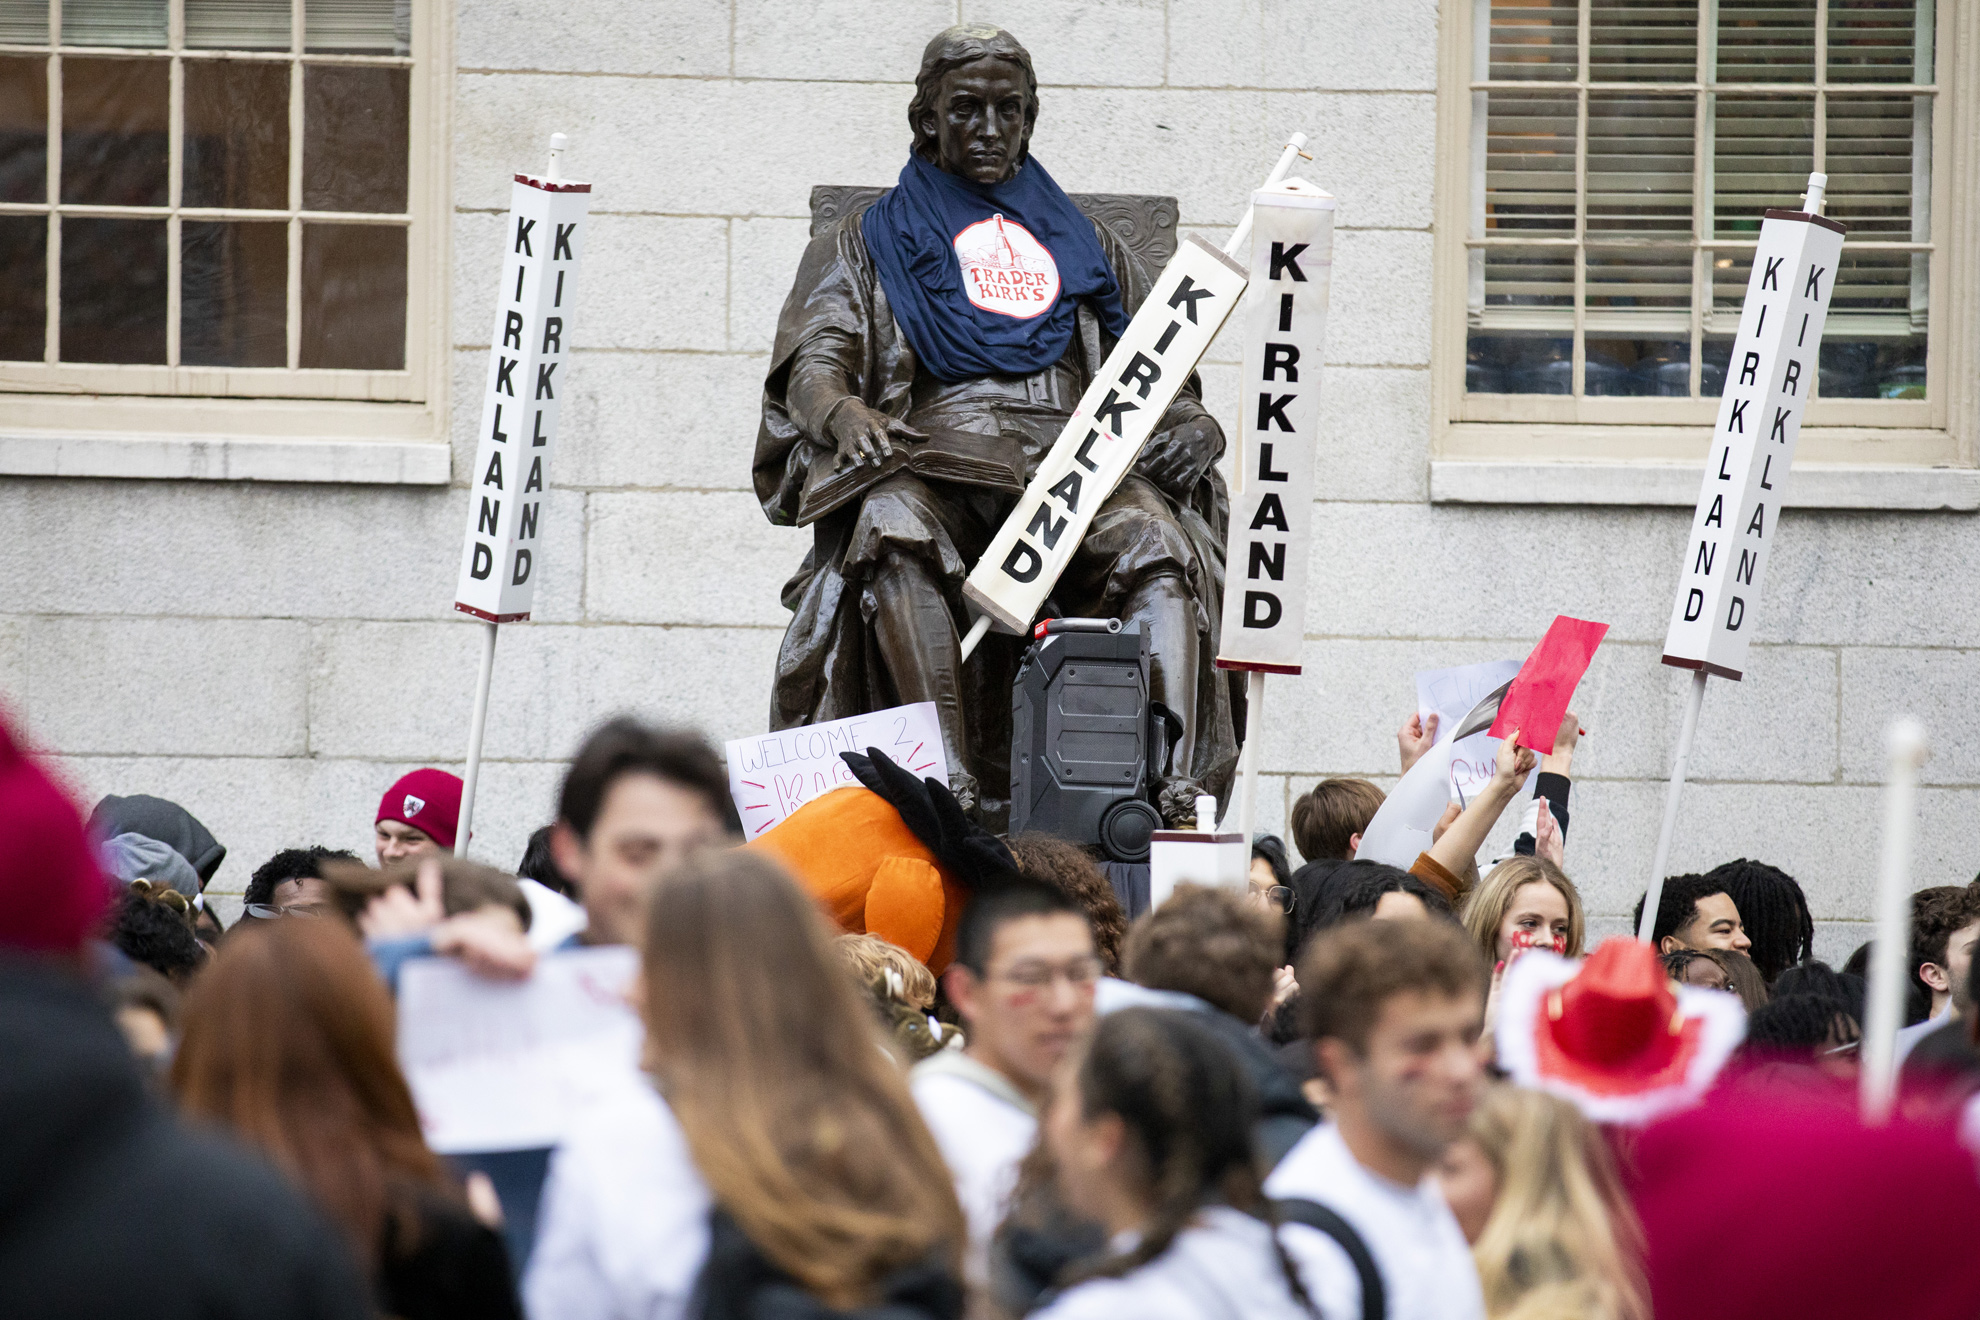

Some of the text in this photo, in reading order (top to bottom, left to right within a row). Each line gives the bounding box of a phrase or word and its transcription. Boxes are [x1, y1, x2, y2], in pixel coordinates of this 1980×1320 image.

[470, 216, 537, 581] KIRKLAND
[511, 223, 577, 586] KIRKLAND
[970, 267, 1049, 287] TRADER
[978, 283, 1045, 302] KIRK'S
[1000, 274, 1215, 584] KIRKLAND
[1242, 241, 1310, 630] KIRKLAND
[1683, 256, 1785, 622] KIRKLAND
[1725, 263, 1826, 632] KIRKLAND
[739, 716, 914, 773] WELCOME 2
